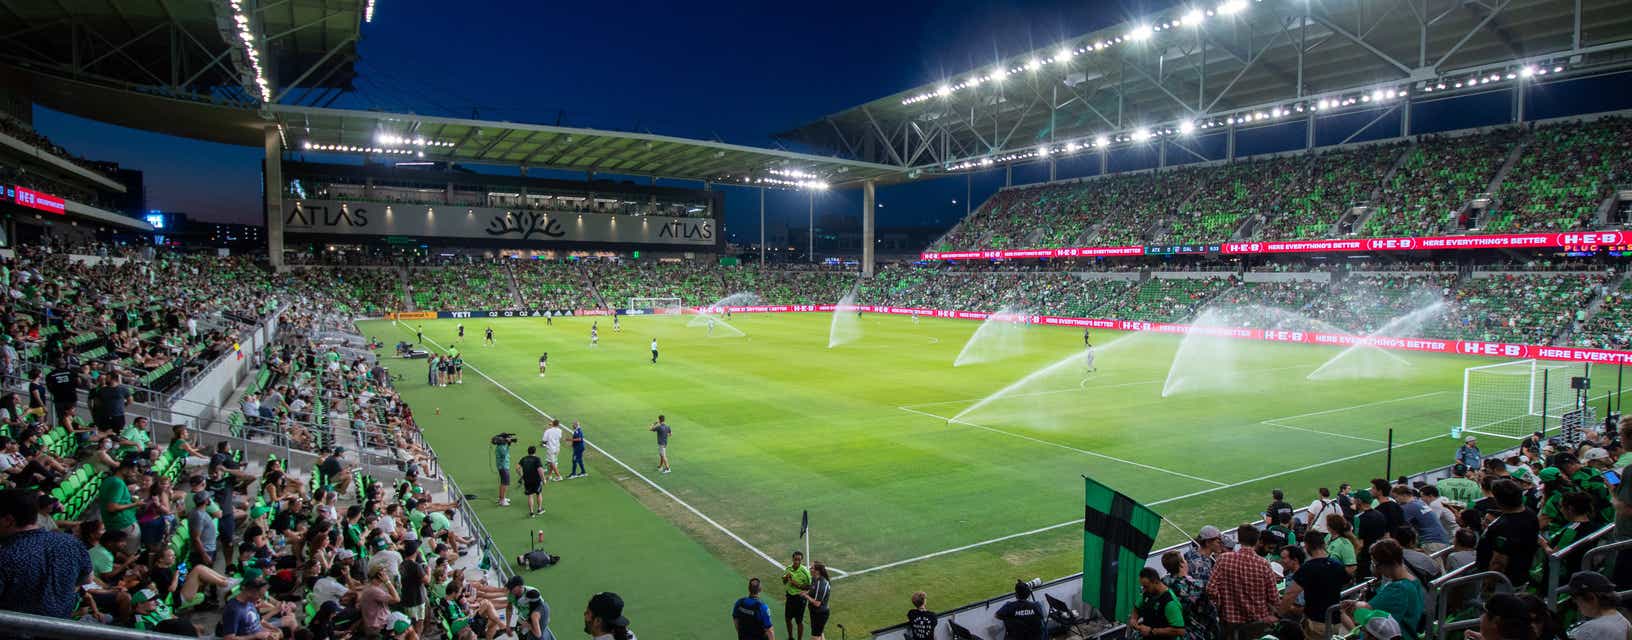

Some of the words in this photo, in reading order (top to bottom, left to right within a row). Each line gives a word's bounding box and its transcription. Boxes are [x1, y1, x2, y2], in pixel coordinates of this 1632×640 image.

[286, 206, 369, 228] ATLAS
[659, 222, 712, 240] ATLAS
[1372, 239, 1411, 248] H-E-B
[1564, 234, 1617, 244] H-E-B
[1407, 340, 1445, 350] BETTER
[1464, 342, 1521, 356] H-E-B
[1539, 349, 1572, 359] HERE
